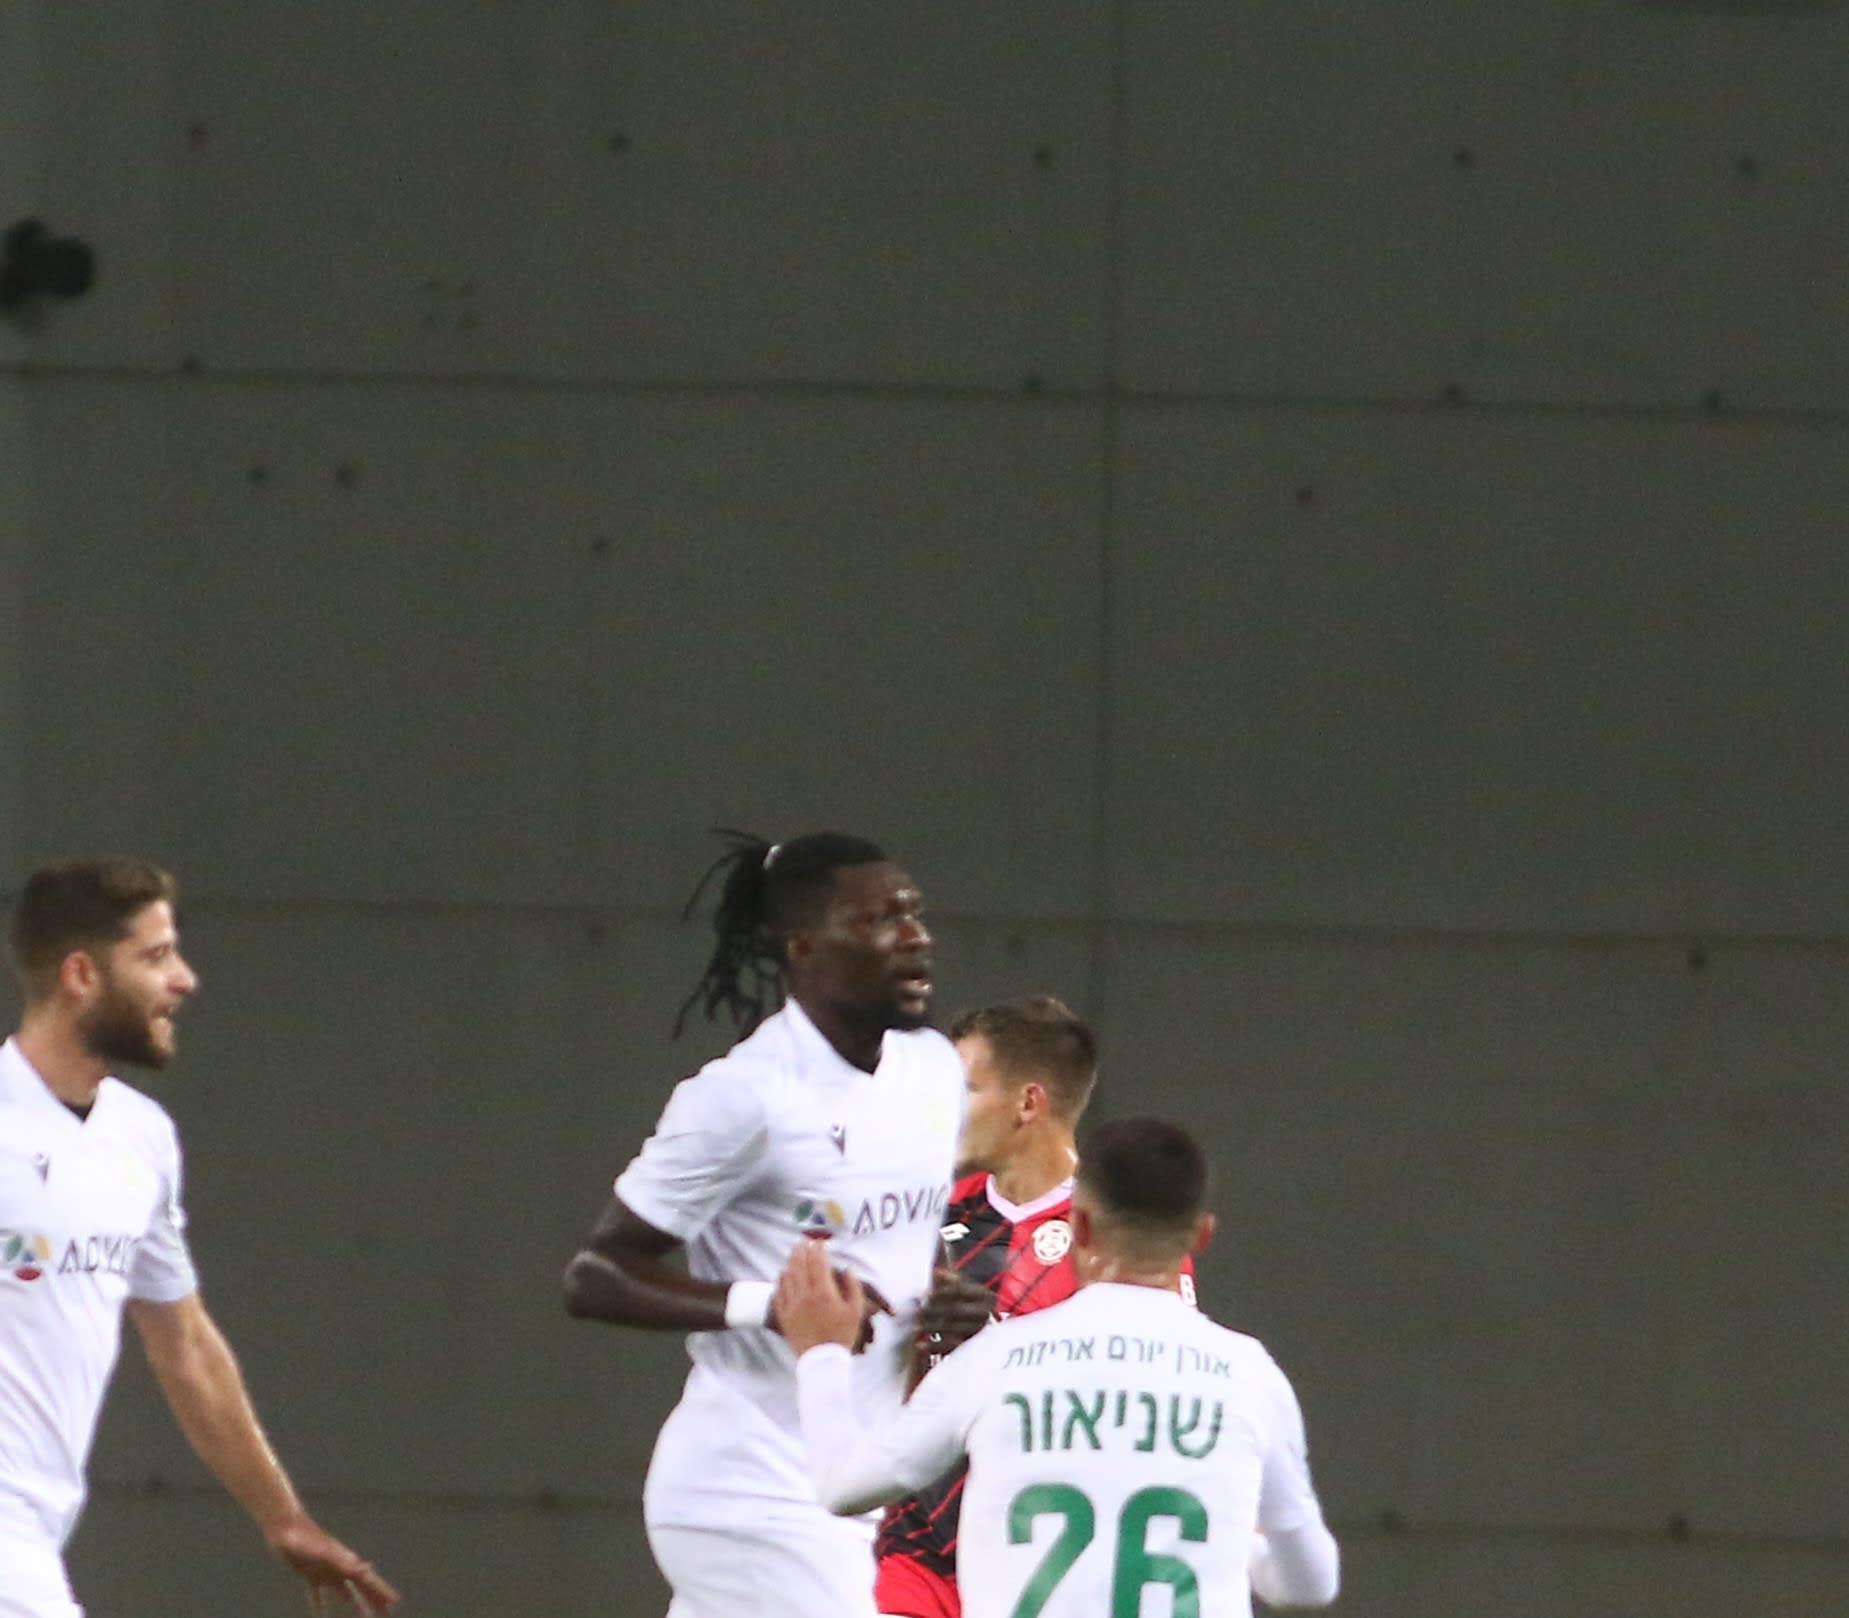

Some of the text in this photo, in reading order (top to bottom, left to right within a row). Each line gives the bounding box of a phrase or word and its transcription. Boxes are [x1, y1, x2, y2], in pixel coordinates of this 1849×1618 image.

[1002, 1335, 1096, 1371] אריזות
[1107, 1333, 1165, 1364] יורם
[1175, 1343, 1232, 1379] אורן
[1003, 1388, 1225, 1461] שניאור
